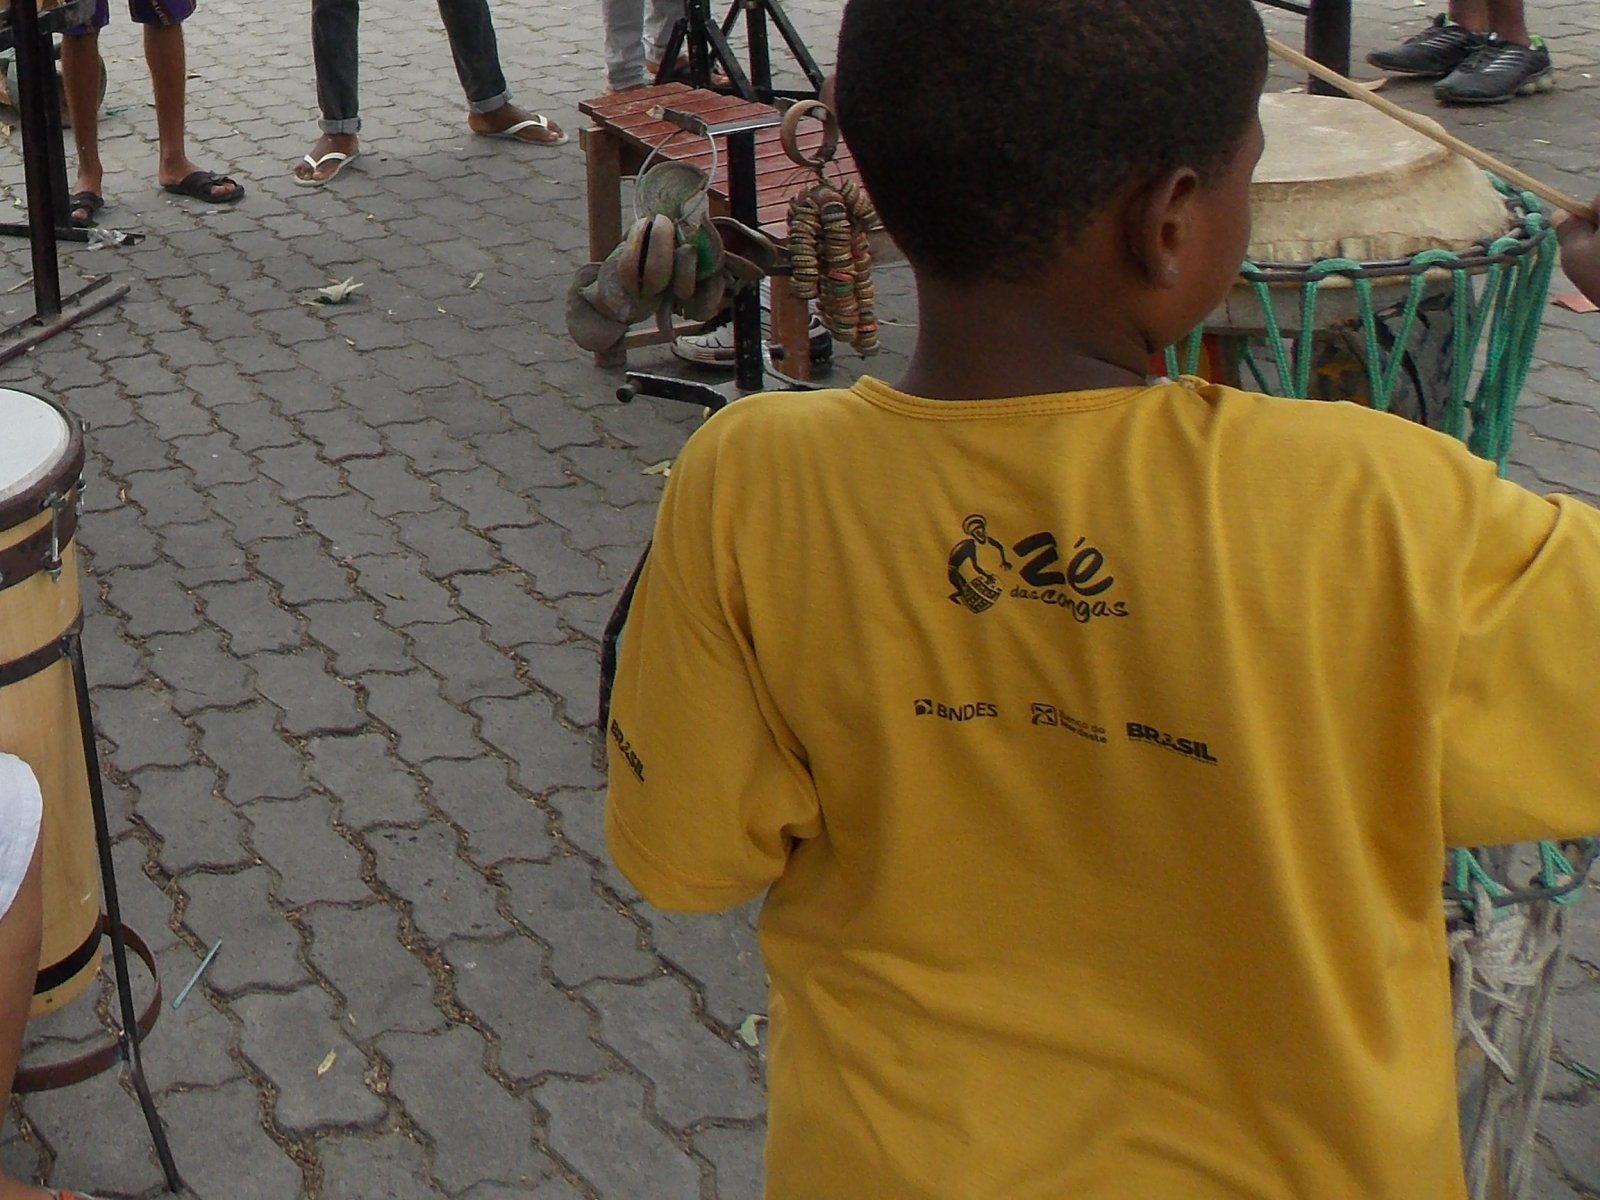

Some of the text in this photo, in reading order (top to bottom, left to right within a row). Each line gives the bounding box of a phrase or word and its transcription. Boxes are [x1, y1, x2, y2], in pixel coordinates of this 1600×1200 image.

[1010, 585, 1039, 600] das
[936, 701, 999, 722] BNDES
[1126, 721, 1218, 763] BRASIL
